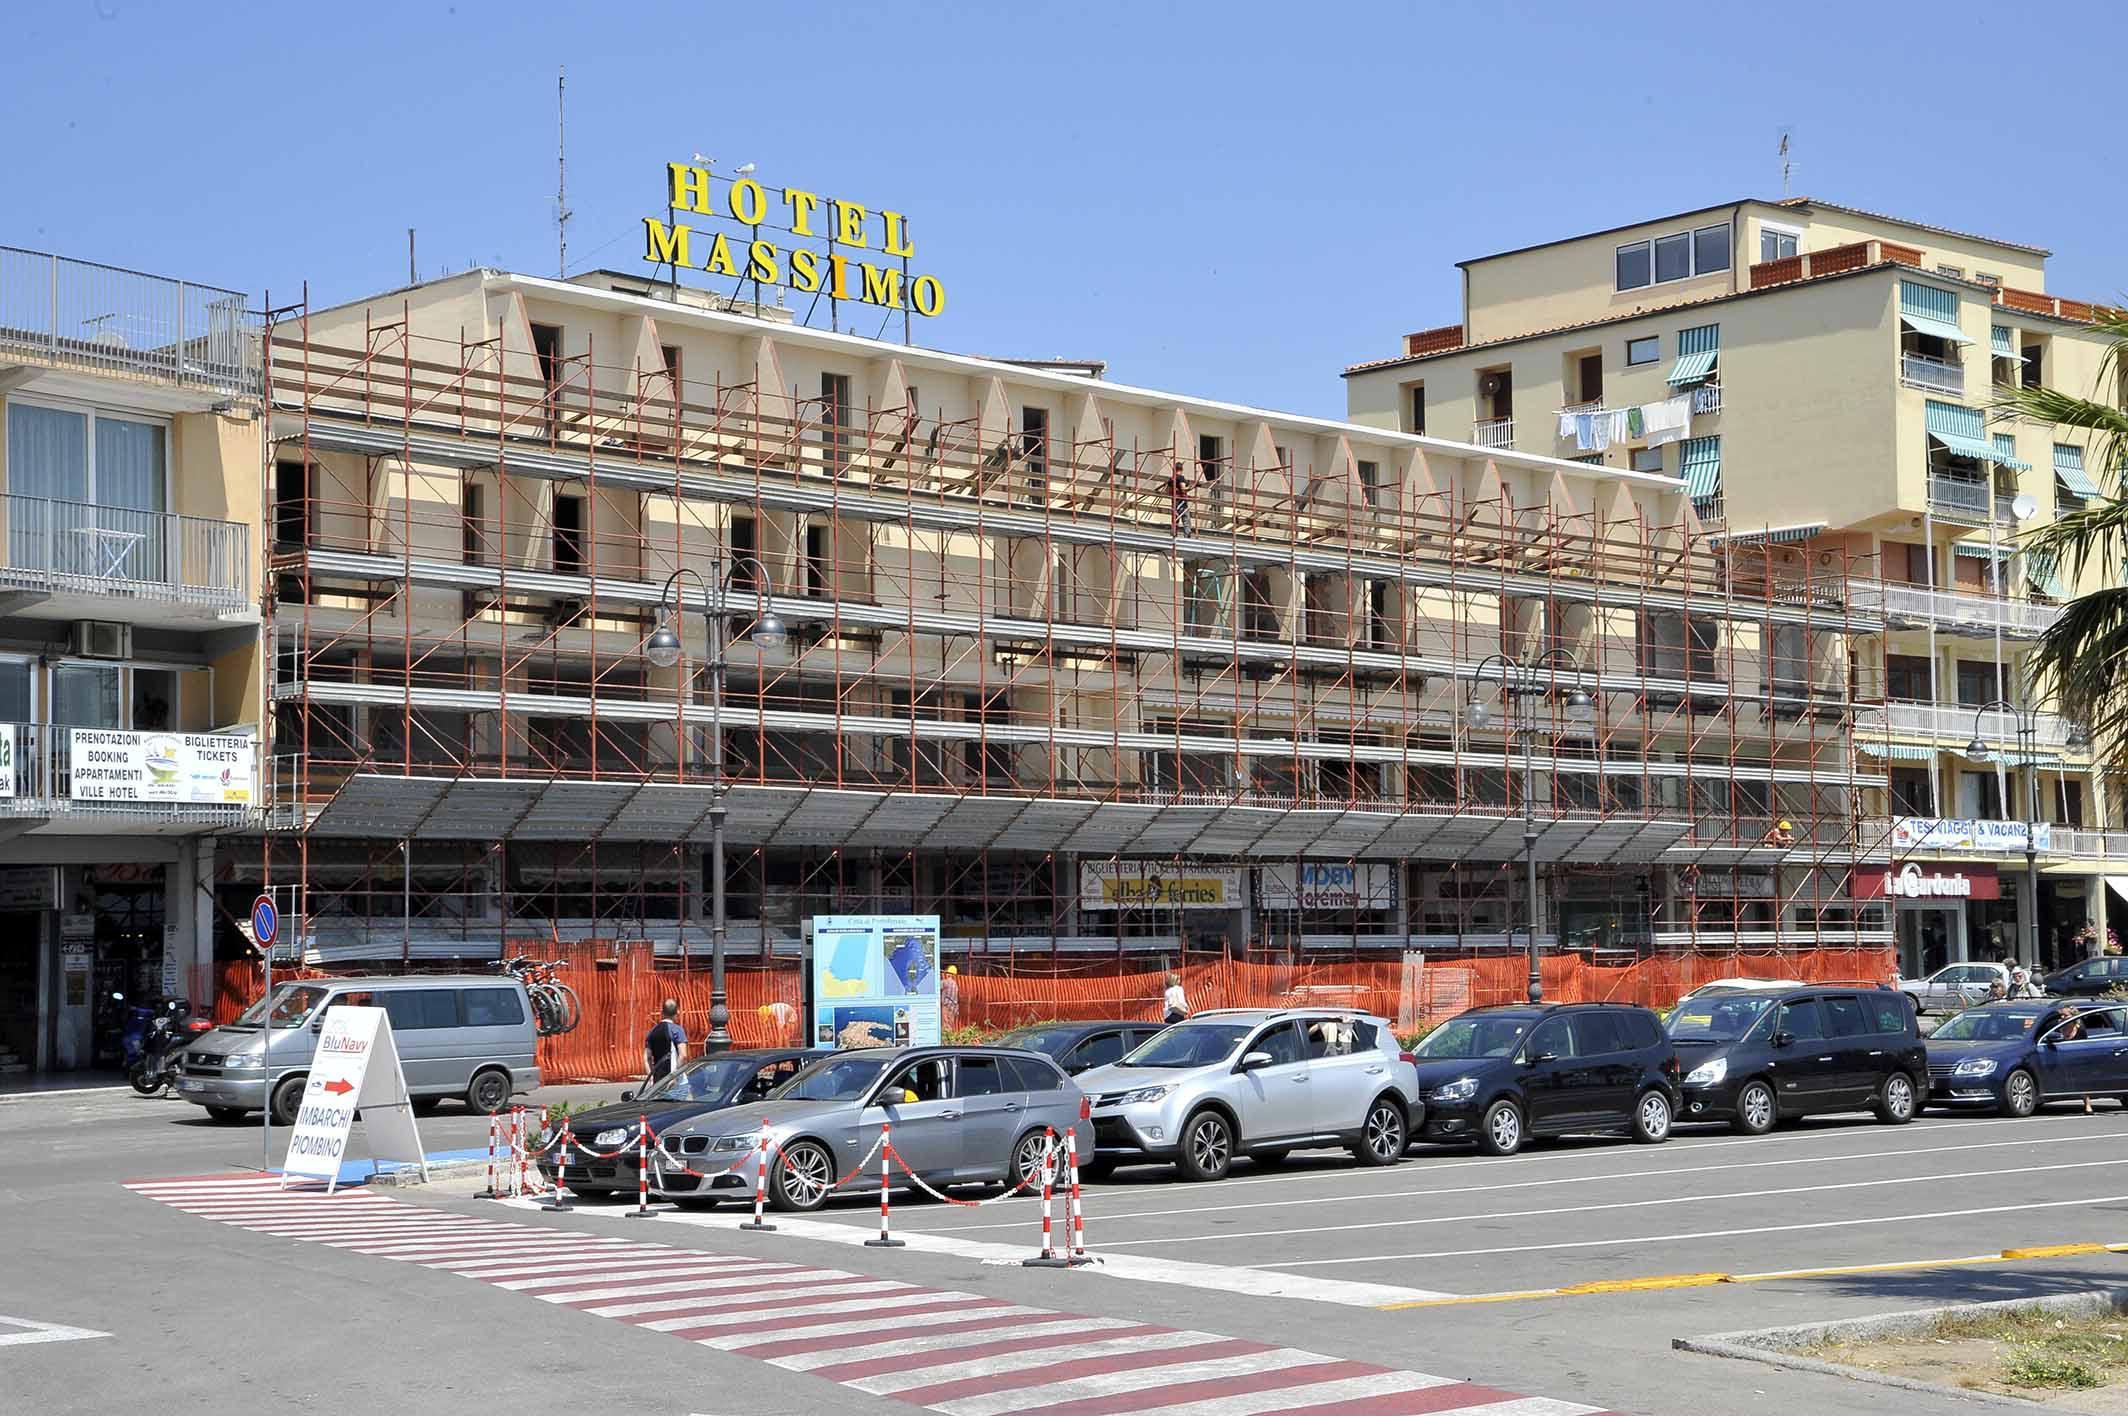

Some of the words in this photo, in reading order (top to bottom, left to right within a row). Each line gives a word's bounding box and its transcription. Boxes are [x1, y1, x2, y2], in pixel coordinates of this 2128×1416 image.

[668, 162, 914, 258] HOTEL
[642, 217, 945, 317] MASSIMO
[75, 732, 141, 746] PRENOTAZIONI
[185, 736, 249, 749] BIGLIETTERIA
[88, 750, 128, 763] BOOKING
[197, 750, 238, 762] TICKETS
[75, 768, 142, 781] APPARTAMENTI
[80, 786, 104, 798] VILLE
[109, 787, 138, 799] HOTEL
[1988, 822, 2029, 837] VACANZ
[1168, 881, 1216, 903] ferries
[1298, 890, 1361, 907] oremar
[322, 1035, 369, 1051] BluNavy
[298, 1106, 351, 1128] IMBARCHI
[291, 1135, 342, 1158] PIOMBINO
